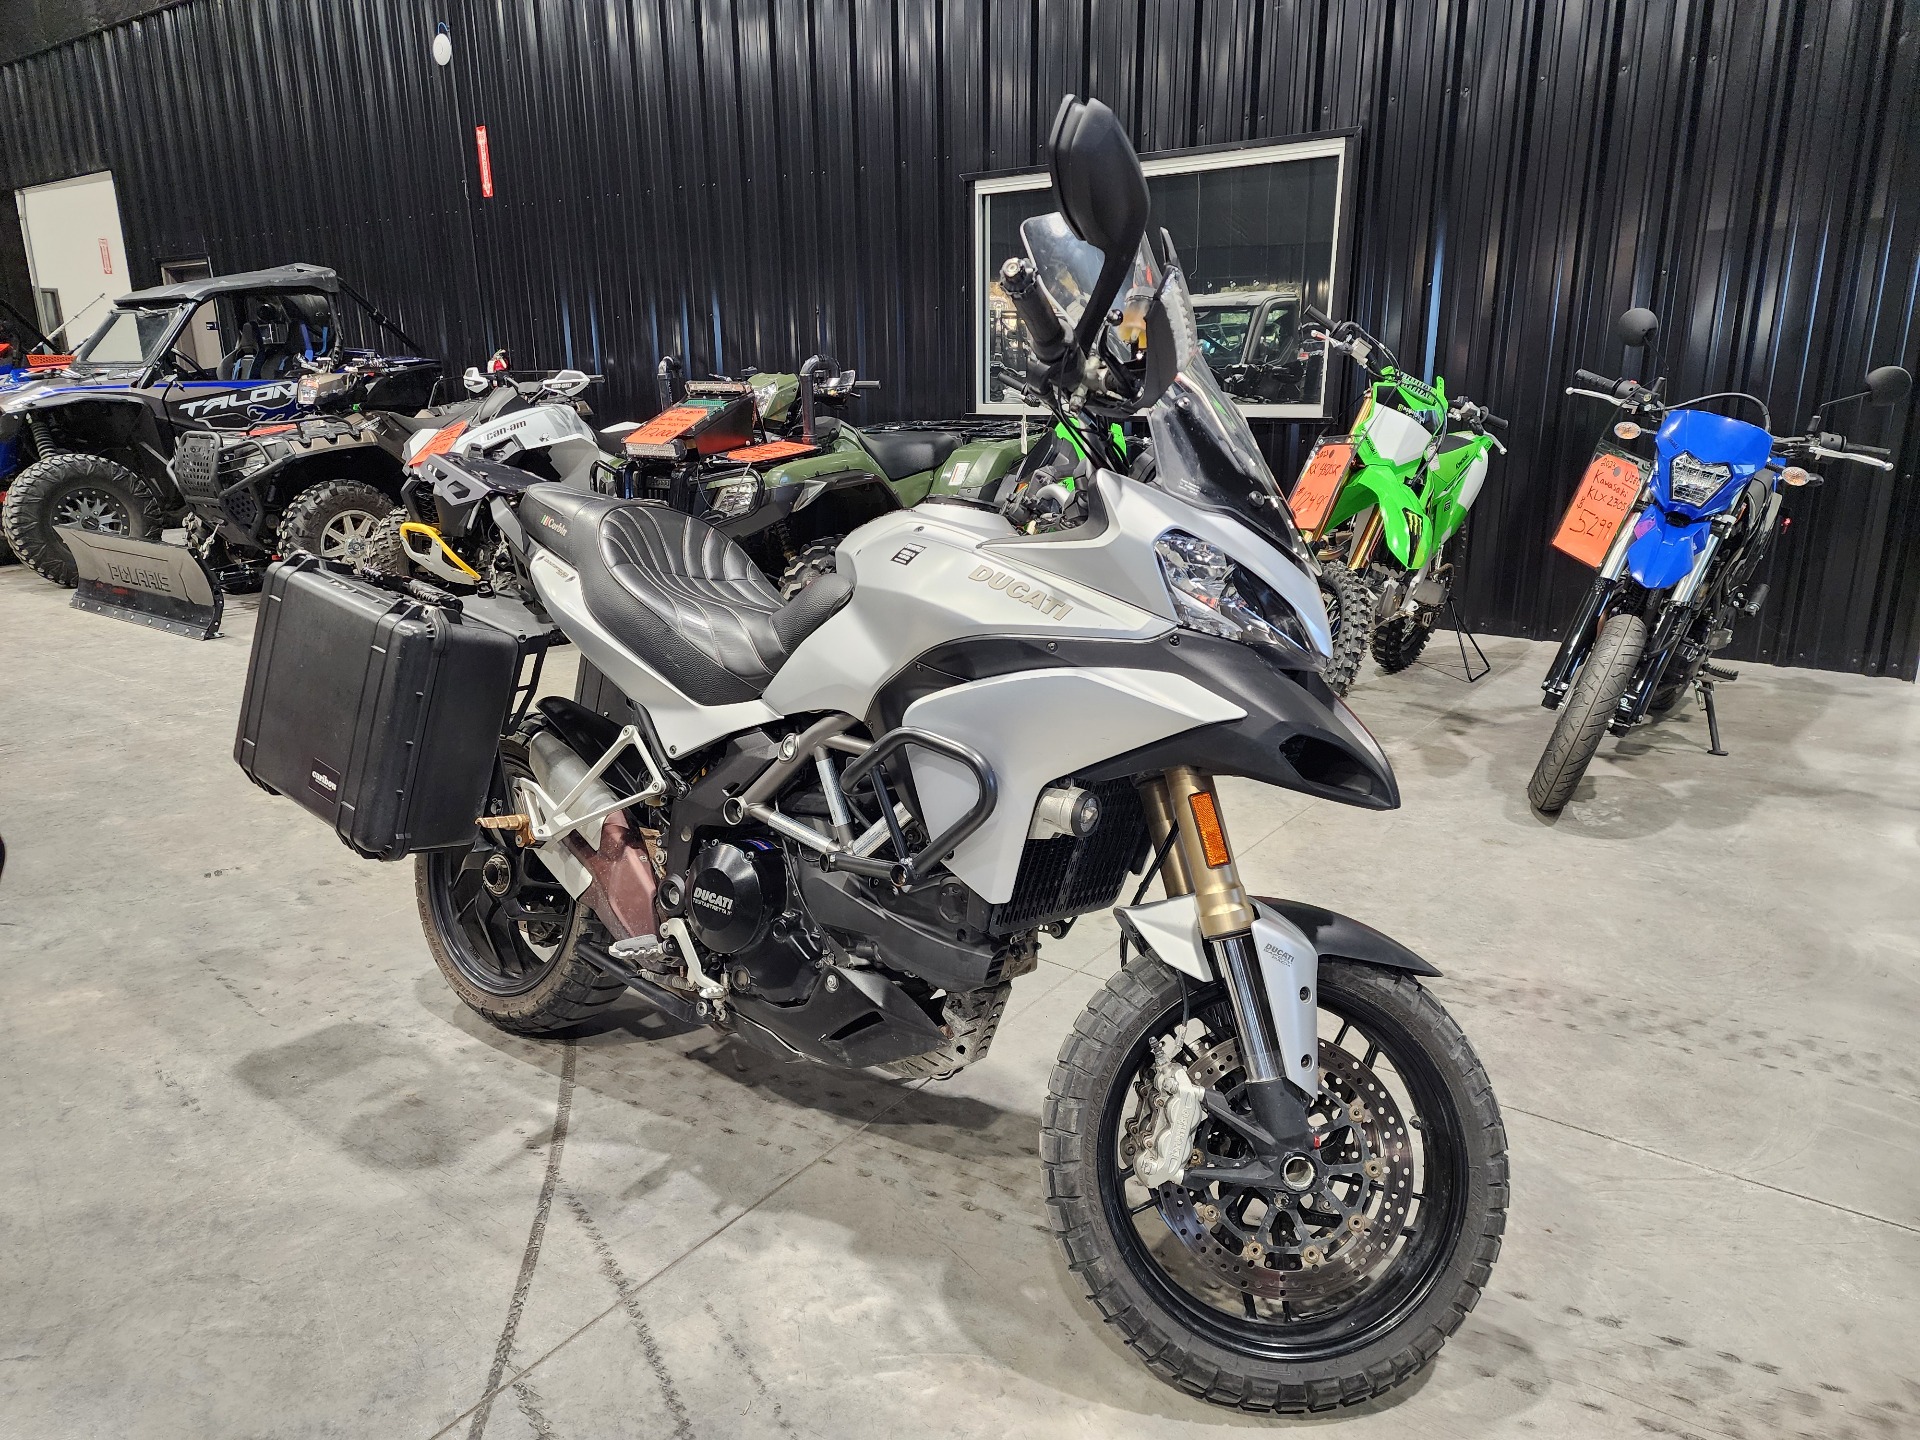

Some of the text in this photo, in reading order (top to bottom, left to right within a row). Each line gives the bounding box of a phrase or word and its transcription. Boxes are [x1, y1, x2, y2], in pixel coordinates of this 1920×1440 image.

[179, 381, 297, 418] TALON
[486, 420, 527, 441] can-am
[1587, 486, 1608, 503] KLX
[549, 518, 568, 537] Corbin
[968, 564, 1074, 621] DUCATI
[312, 770, 337, 791] caribou
[693, 886, 734, 910] DUCATI
[1265, 943, 1295, 963] DUCATI
